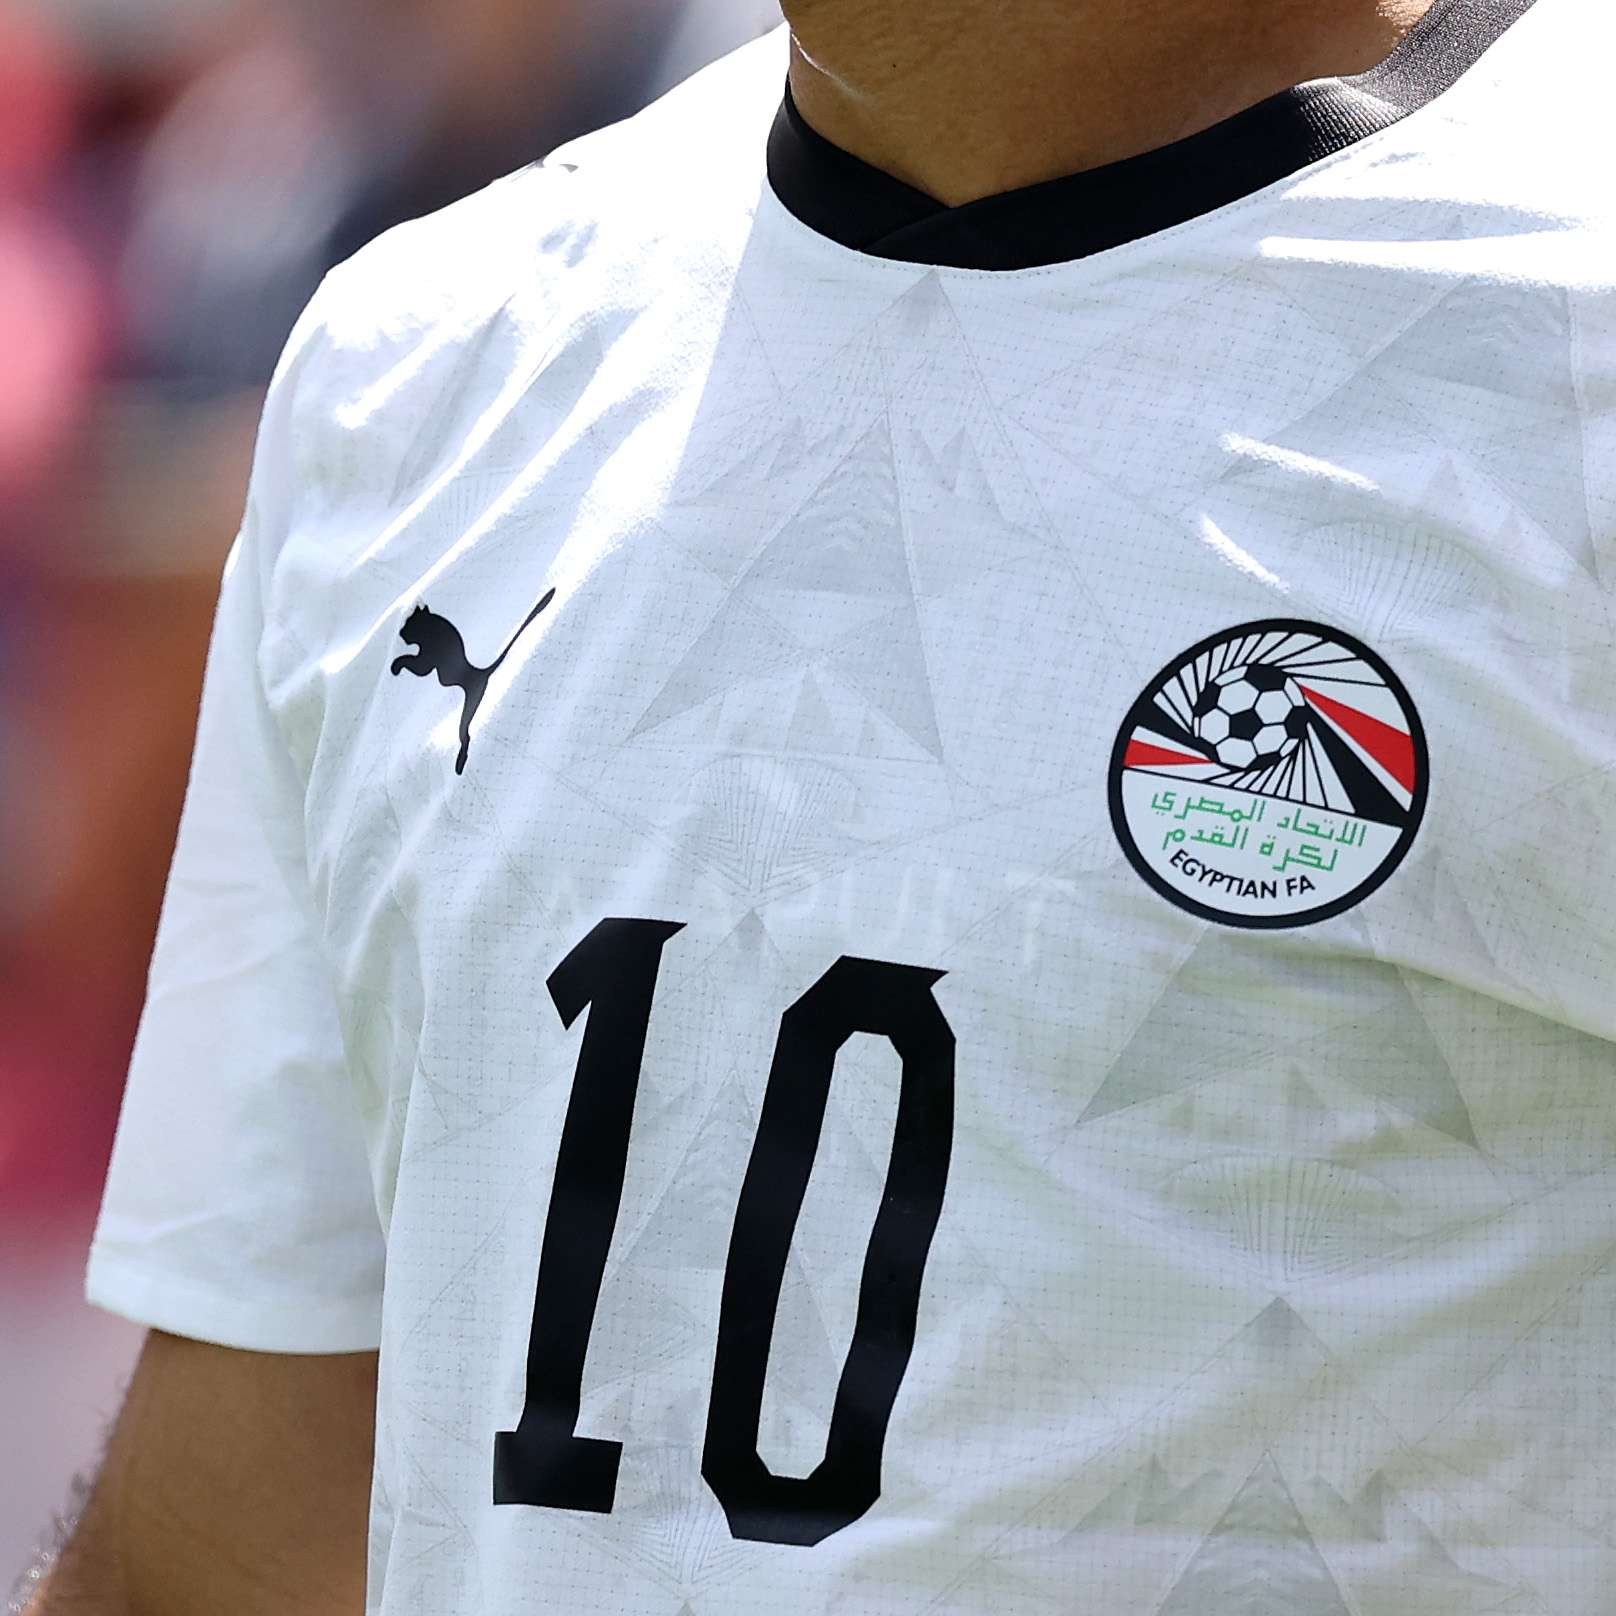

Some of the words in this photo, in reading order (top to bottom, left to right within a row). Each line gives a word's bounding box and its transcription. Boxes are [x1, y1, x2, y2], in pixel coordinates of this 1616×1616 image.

[1162, 825, 1249, 850] القدم
[1277, 808, 1367, 847] الاتحاد
[1259, 834, 1338, 872] لكرة
[1169, 848, 1277, 899] EGYPTIAN
[1286, 875, 1316, 896] FA
[493, 917, 957, 1547] 10
